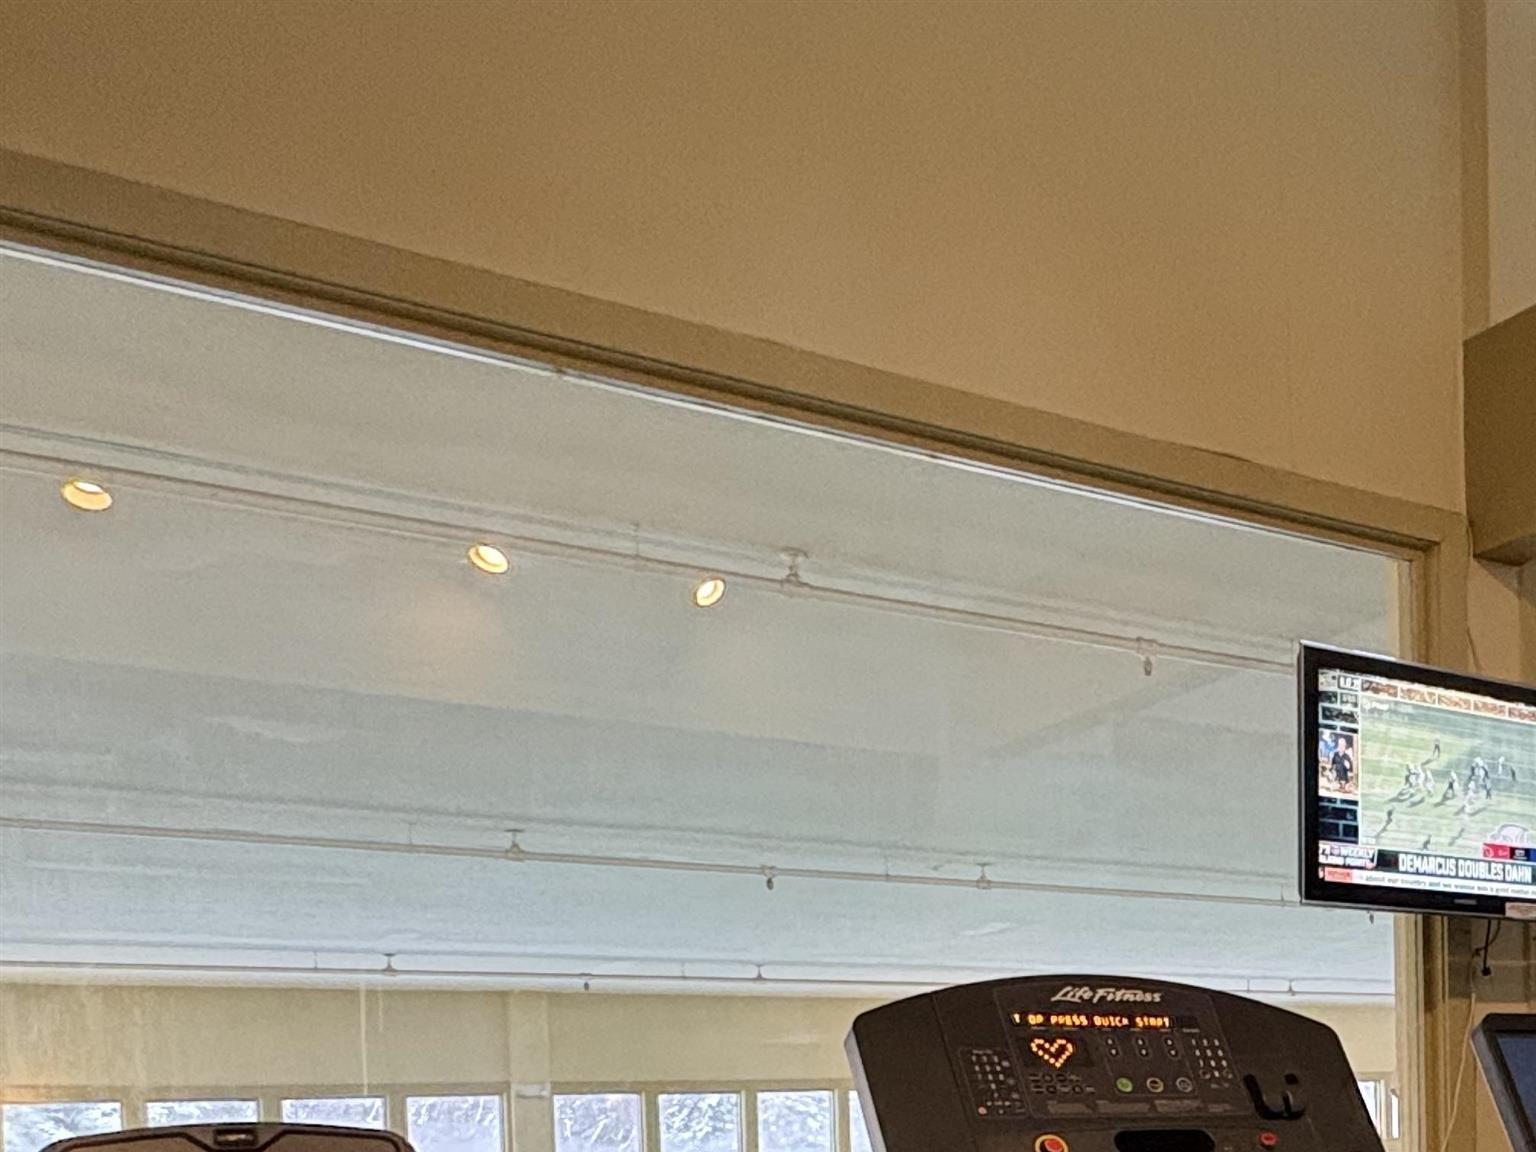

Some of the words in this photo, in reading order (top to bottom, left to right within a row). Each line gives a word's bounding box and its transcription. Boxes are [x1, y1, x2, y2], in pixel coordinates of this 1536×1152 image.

[1399, 853, 1456, 876] DEMARCUS
[1458, 858, 1503, 880] DOUBLES
[1051, 986, 1093, 1003] Life
[1093, 988, 1162, 1003] Fitness
